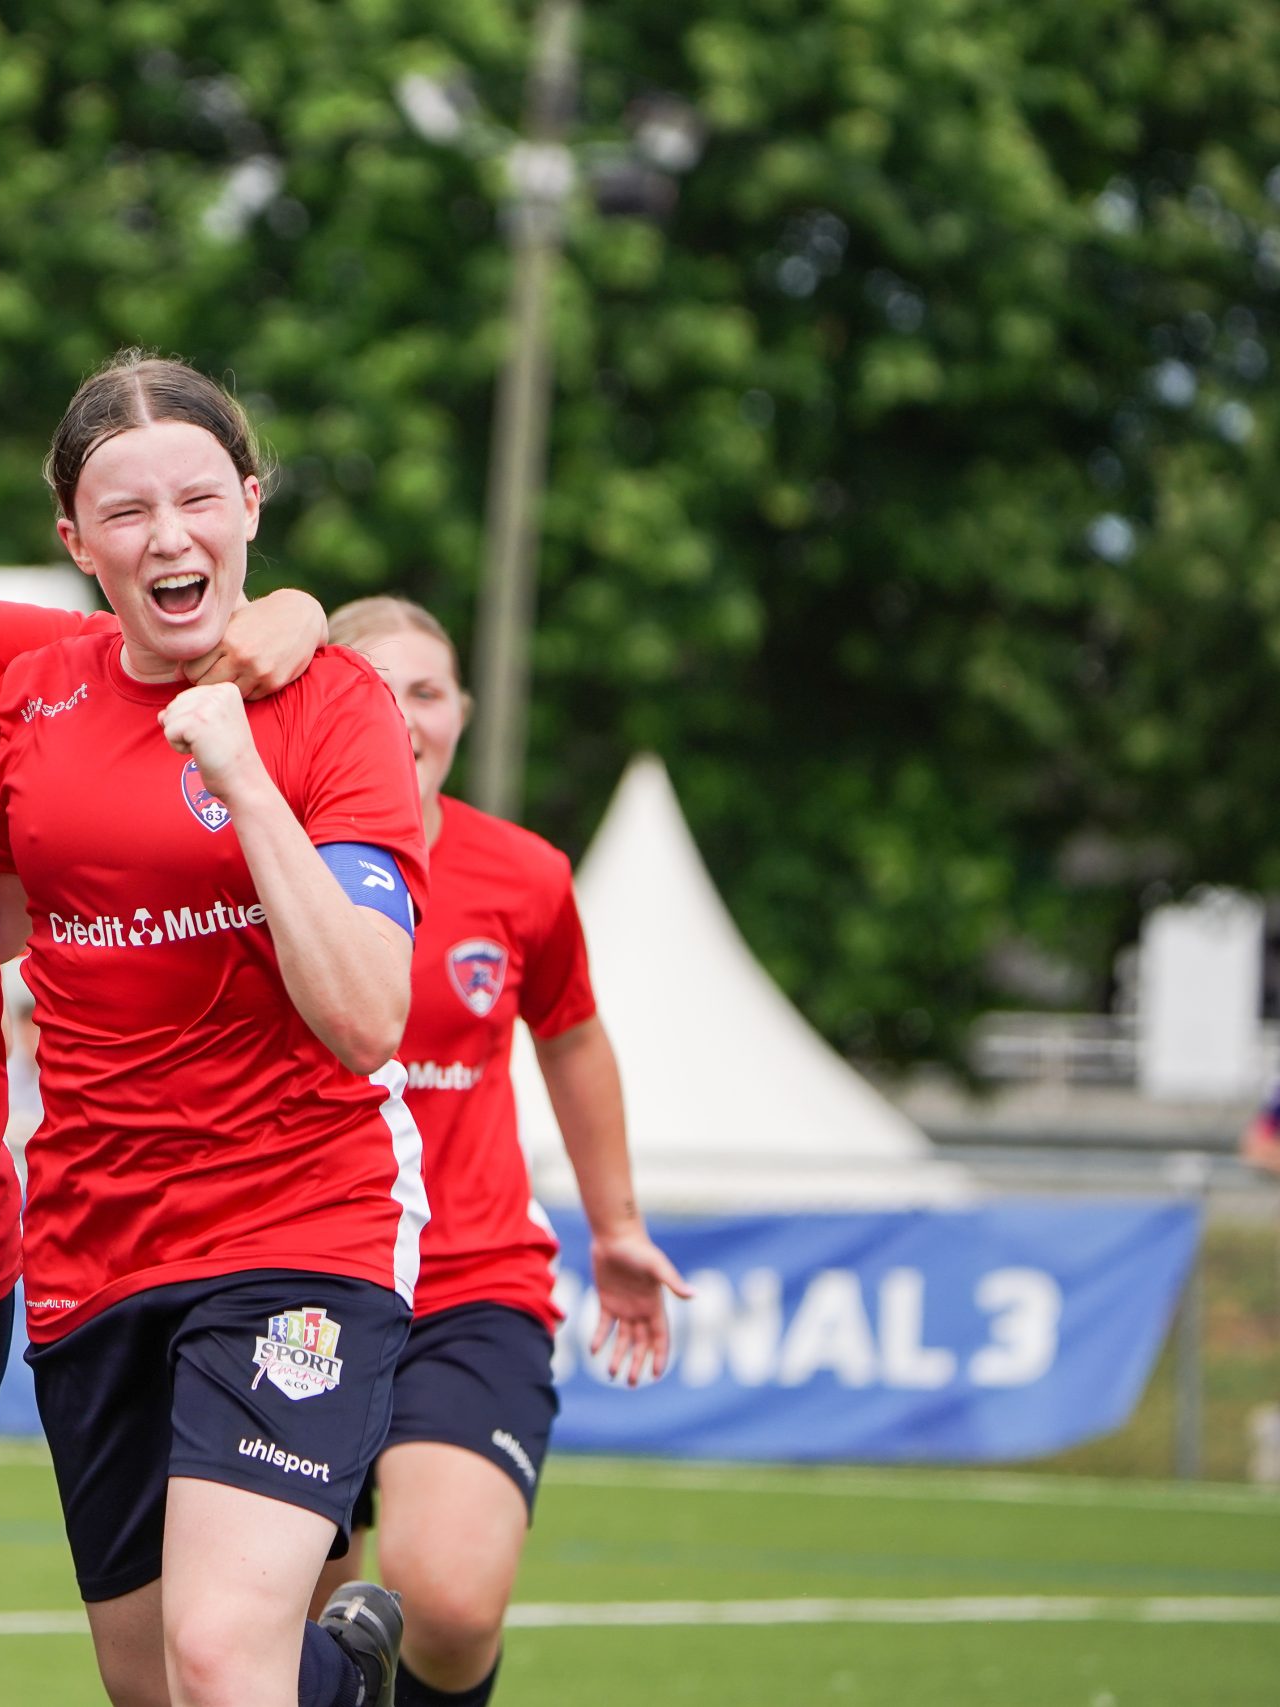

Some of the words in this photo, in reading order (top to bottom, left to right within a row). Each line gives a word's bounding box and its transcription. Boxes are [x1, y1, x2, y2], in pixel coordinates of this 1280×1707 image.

[20, 683, 88, 723] uhlsport
[206, 810, 223, 821] 63
[49, 911, 127, 947] Crédit
[163, 900, 266, 942] Mutue
[968, 1267, 1063, 1388] 3
[260, 1342, 339, 1377] SPORT
[294, 1382, 309, 1391] CO
[238, 1438, 330, 1482] uhlsport
